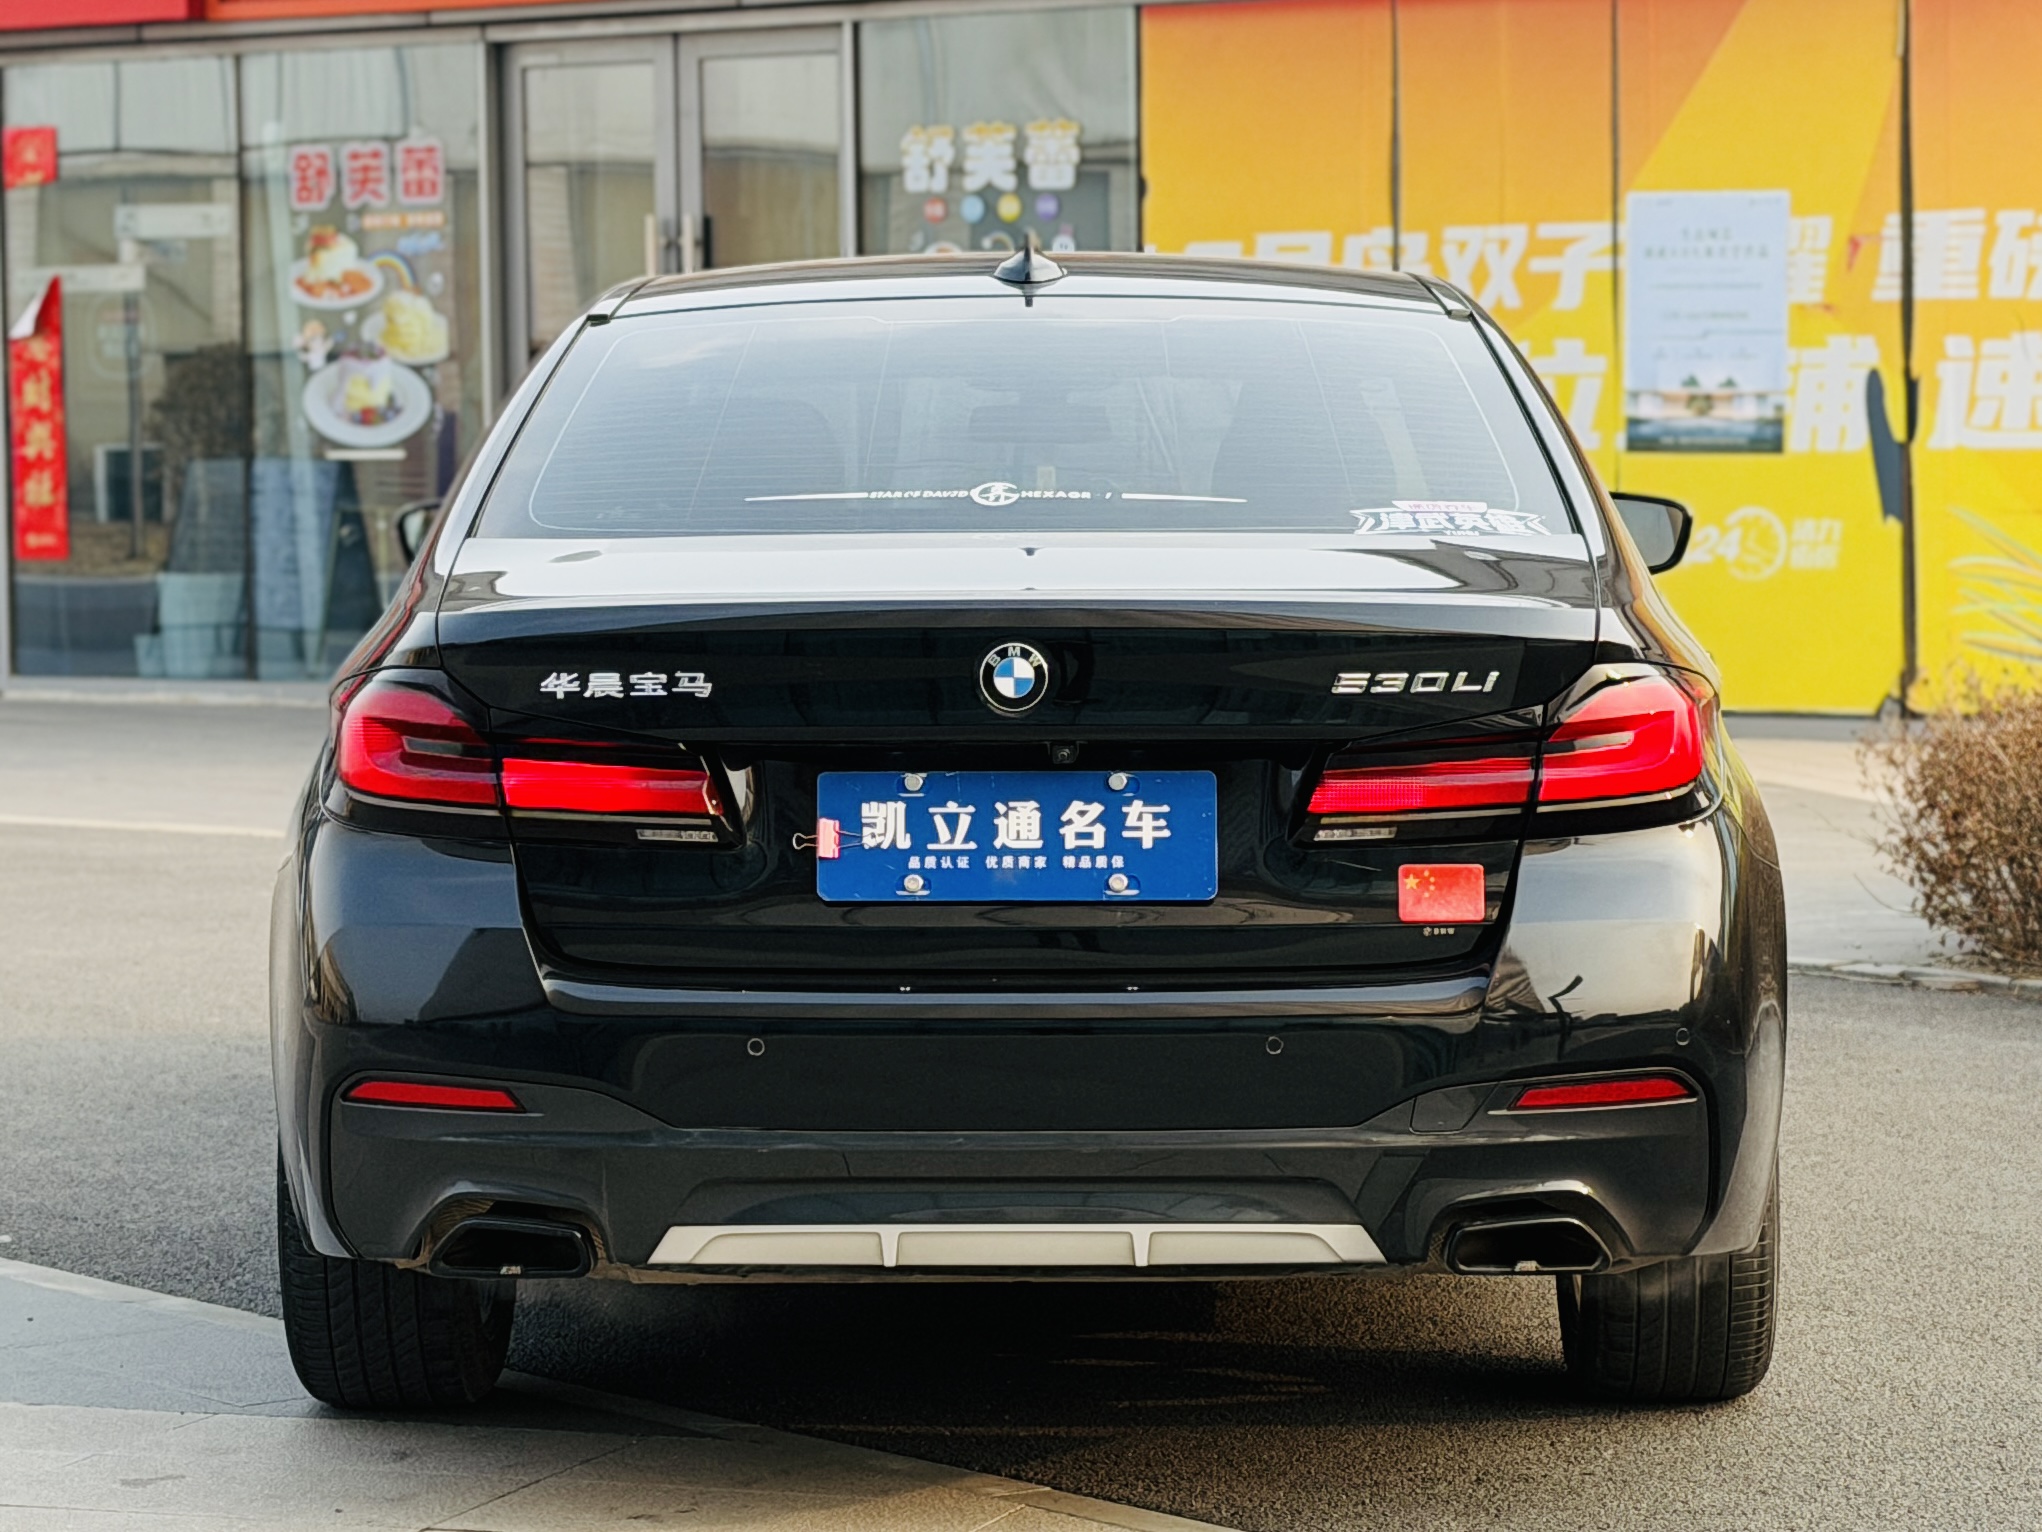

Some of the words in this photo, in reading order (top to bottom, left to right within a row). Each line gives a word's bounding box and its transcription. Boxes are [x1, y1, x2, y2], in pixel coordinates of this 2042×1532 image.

[291, 144, 440, 206] 舒芙蕾
[987, 646, 1042, 668] BMW
[540, 671, 713, 700] 华晨宝马
[860, 800, 1172, 850] 凯立通名车
[907, 855, 971, 869] 品质认证
[985, 855, 1048, 869] 优质商家
[1062, 855, 1125, 869] 精品质保
